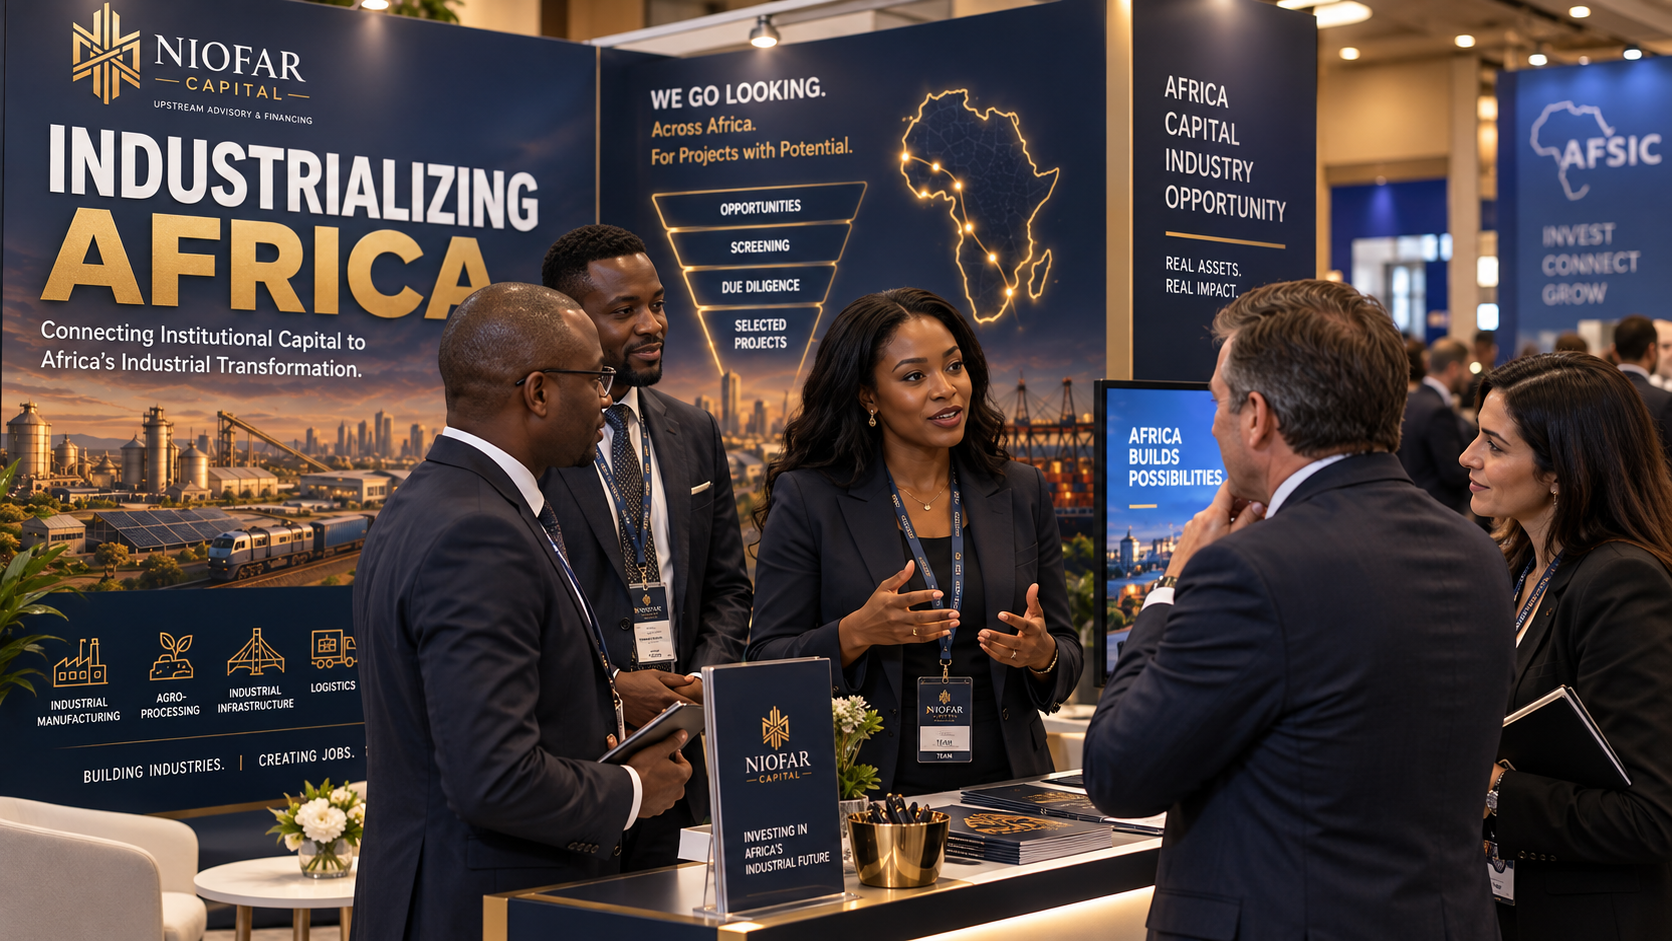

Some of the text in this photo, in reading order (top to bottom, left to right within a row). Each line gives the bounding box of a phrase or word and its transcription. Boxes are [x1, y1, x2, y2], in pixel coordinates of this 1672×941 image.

[154, 33, 306, 83] NIOFAR
[186, 76, 282, 101] CAPITAL
[651, 77, 826, 110] WE GO LOOKING.
[1164, 75, 1229, 108] AFRICA
[153, 100, 313, 125] UPSTREAM ADVISORY & FINANCING
[651, 115, 757, 138] Across Africa.
[1164, 111, 1240, 146] CAPITAL
[651, 136, 853, 167] For Projects with Potential.
[1560, 133, 1662, 170] AFSIC
[1165, 148, 1254, 183] INDUSTRY
[49, 123, 539, 232] INDUSTRIALIZING
[720, 199, 802, 216] OPPORTUNITIES
[1165, 184, 1287, 223] OPPORTUNITY
[730, 238, 790, 254] SCREENING
[1542, 222, 1616, 248] INVEST
[40, 207, 493, 320] AFRICA
[1166, 255, 1242, 278] REAL ASSETS.
[1541, 250, 1641, 277] CONNECT
[722, 279, 800, 294] DUE DILIGENCE
[1166, 278, 1239, 299] REAL IMPACT.
[1541, 281, 1608, 306] GROW
[41, 320, 366, 352] Connecting Institutional Capital to
[734, 318, 787, 332] SELECTED
[734, 336, 787, 350] PROJECTS
[40, 350, 362, 379] Africa’s Industrial Transformation.
[1128, 427, 1182, 445] AFRICA
[1129, 448, 1180, 465] BUILDS
[1129, 469, 1222, 487] POSSIBILITIES
[156, 691, 187, 704] AGRO-
[229, 685, 282, 698] INDUSTRIAL
[310, 680, 356, 693] LOGISTICS
[50, 697, 108, 711] INDUSTRIAL
[141, 705, 200, 719] PROCESSING
[217, 699, 294, 713] INFRASTRUCTURE
[926, 705, 963, 714] NIOFAR
[37, 711, 121, 727] MANUFACTURING
[83, 765, 143, 784] BUILDING
[149, 758, 225, 777] INDUSTRIES.
[258, 749, 317, 767] CREATING
[322, 746, 355, 761] JOBS.
[745, 750, 811, 774] NIOFAR
[759, 770, 800, 784] CAPITAL
[744, 823, 808, 843] INVESTING IN
[745, 843, 783, 860] AFRICA'S
[745, 851, 830, 875] INDUSTRIAL FUTURE
